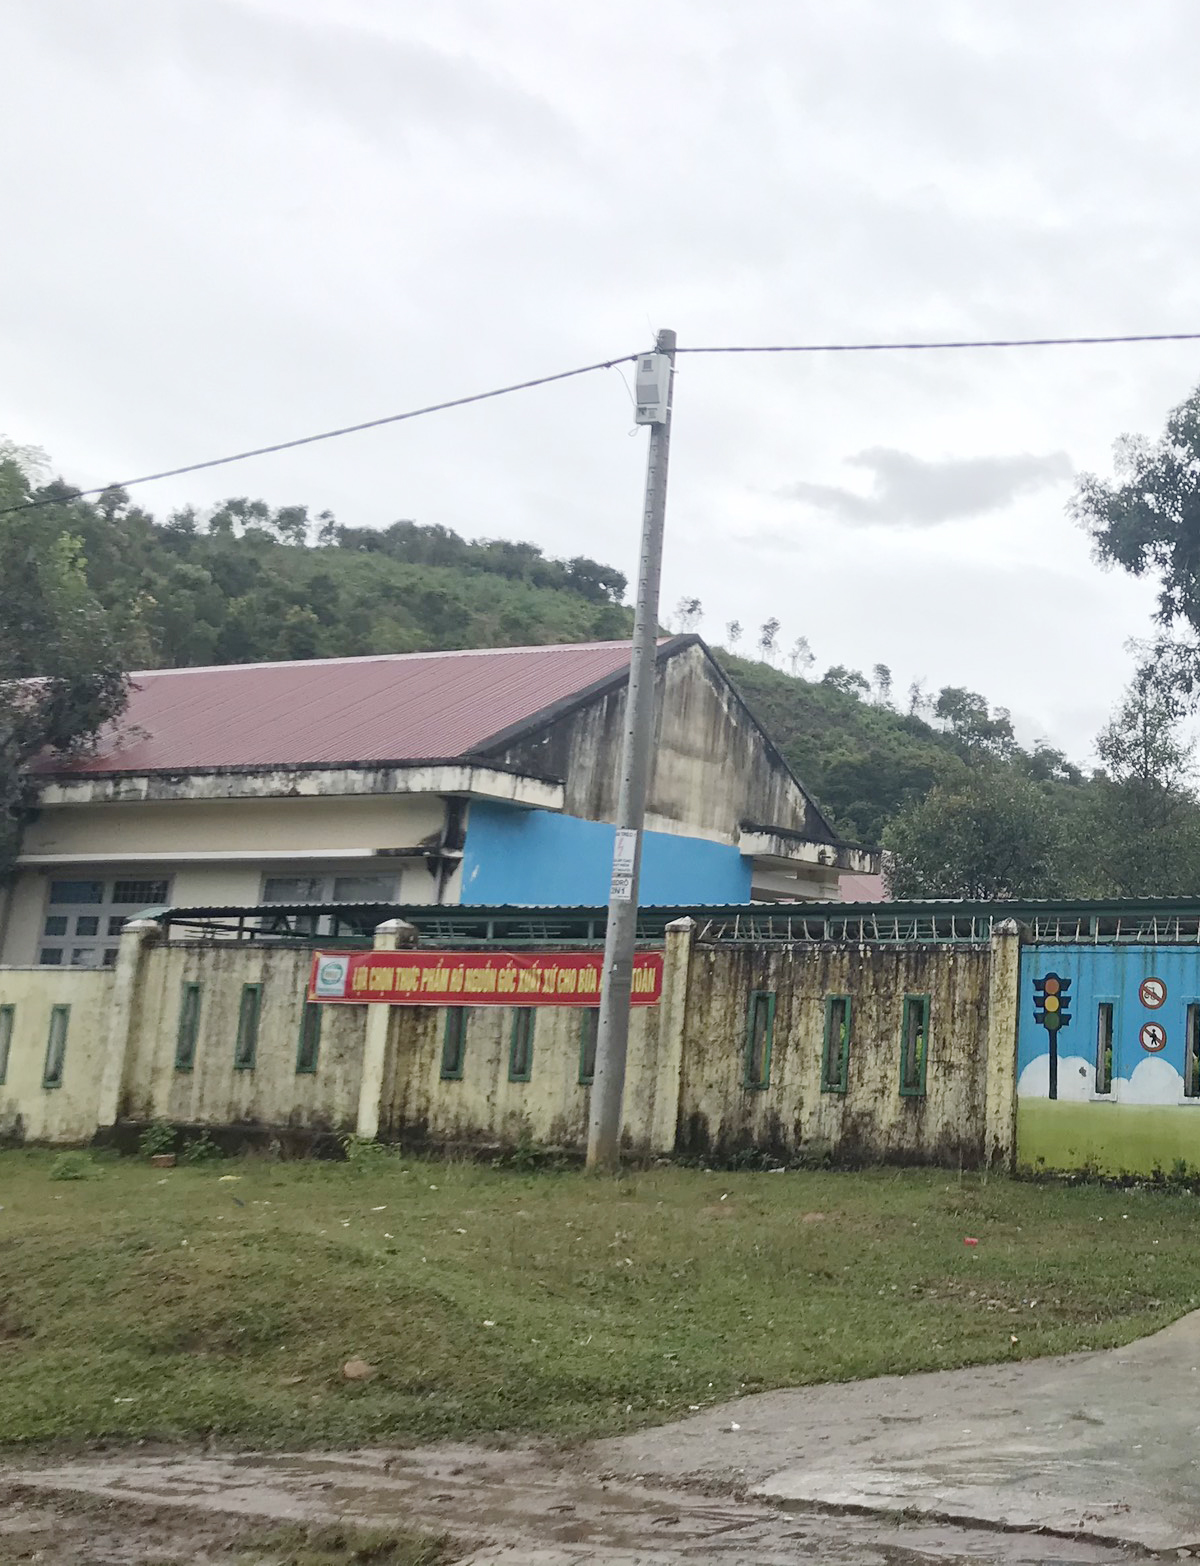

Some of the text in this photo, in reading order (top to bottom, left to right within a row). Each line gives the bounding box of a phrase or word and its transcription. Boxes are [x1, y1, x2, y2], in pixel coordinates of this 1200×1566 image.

[498, 959, 517, 993] GỐC
[557, 967, 577, 993] CHO
[577, 963, 597, 993] BỮA
